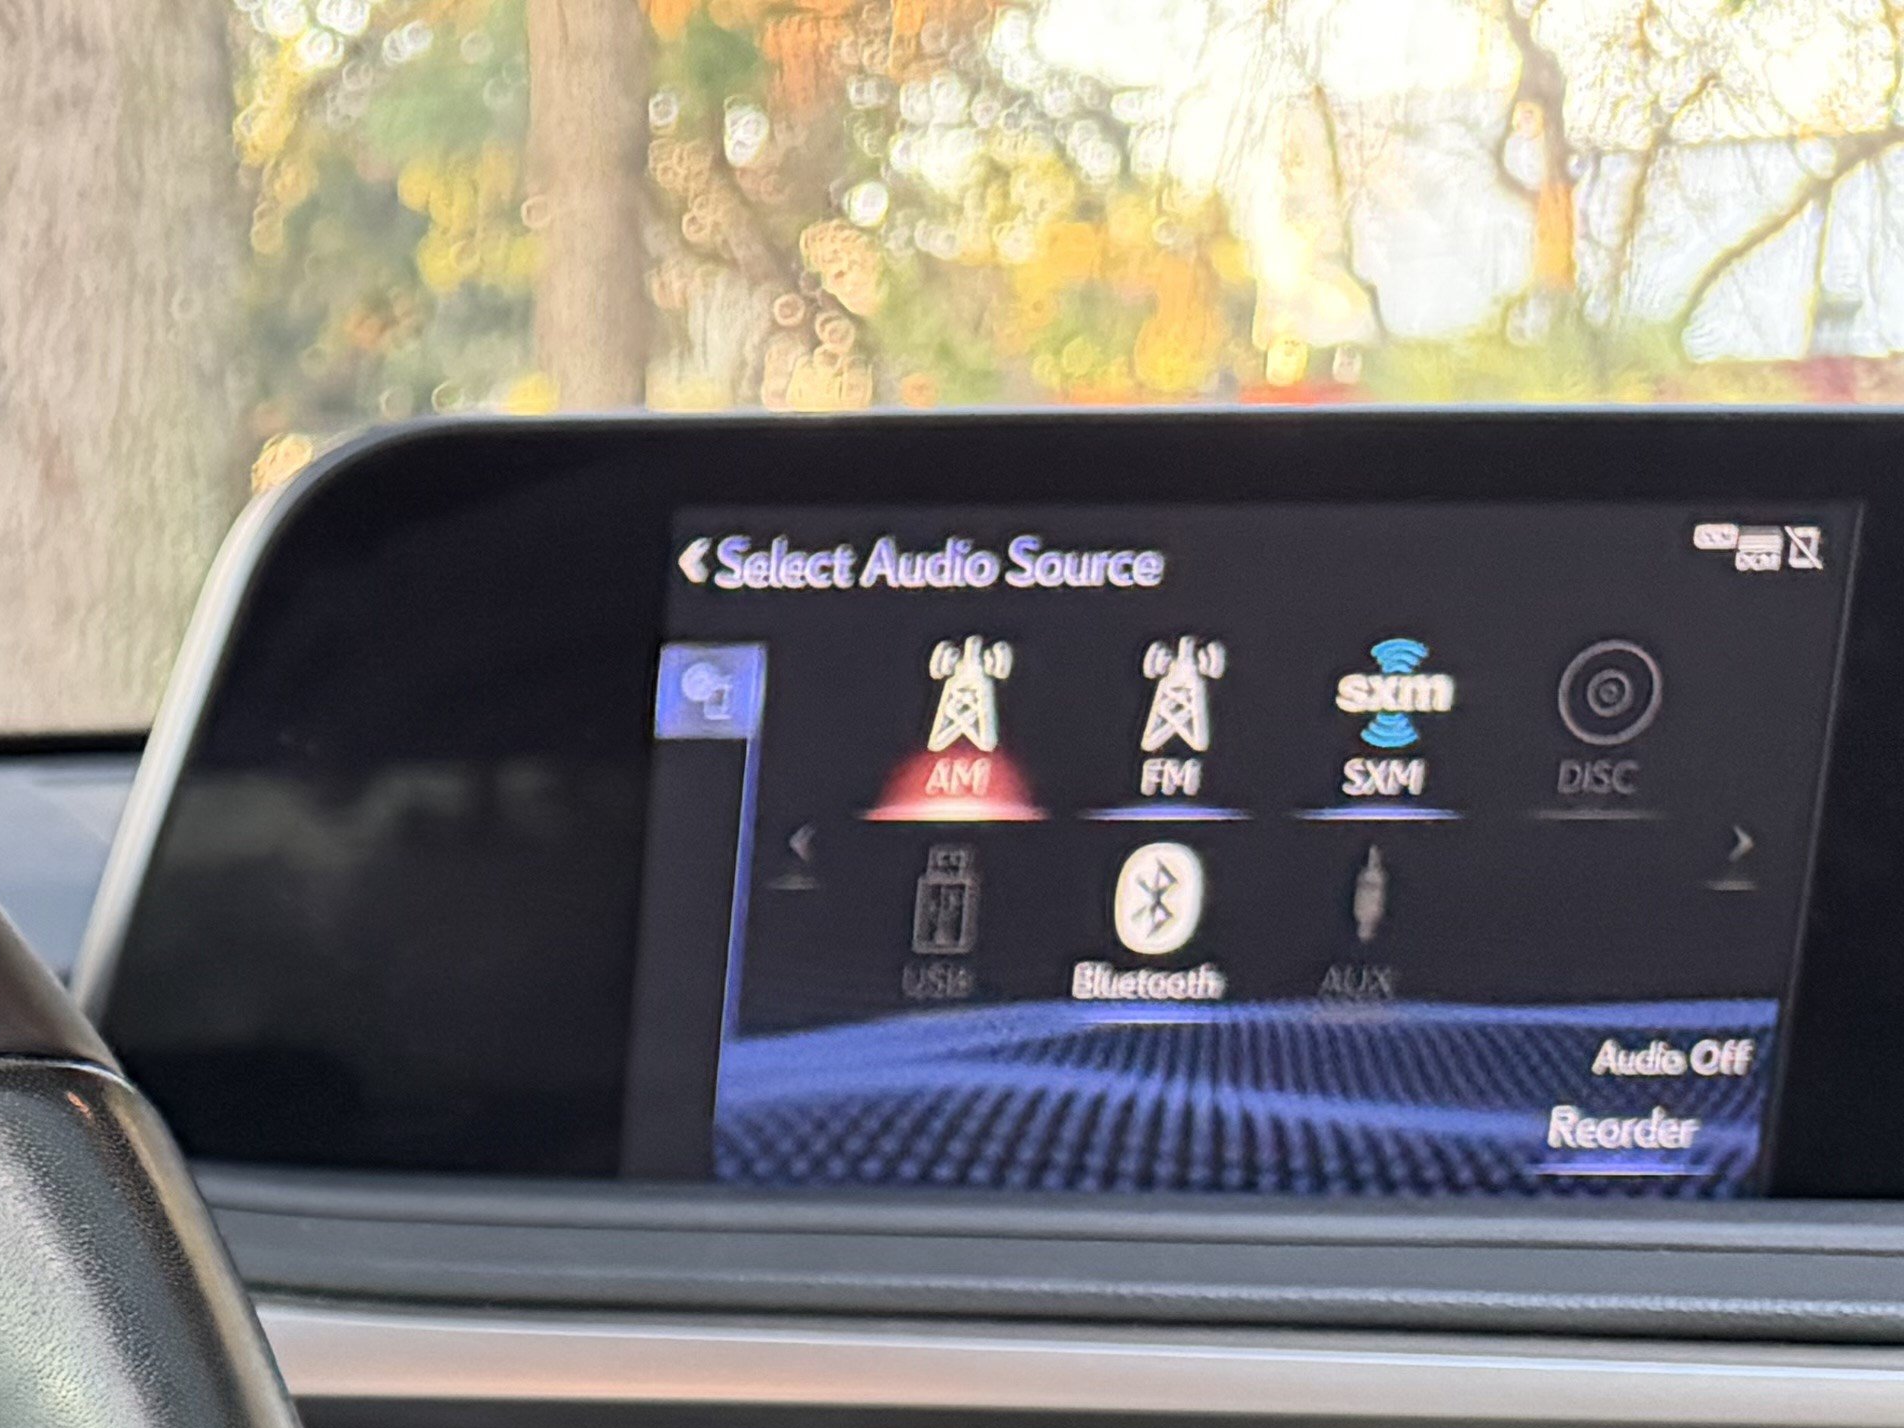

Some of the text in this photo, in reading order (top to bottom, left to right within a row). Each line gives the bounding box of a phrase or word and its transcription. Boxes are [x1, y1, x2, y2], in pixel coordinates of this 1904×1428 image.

[715, 536, 1164, 590] Select Audio Source
[926, 760, 988, 795] AM
[1139, 759, 1200, 796] FM
[1342, 760, 1425, 795] SXM
[1559, 760, 1639, 795] DISC
[902, 965, 974, 997] USB
[1072, 961, 1227, 999] Bluetooth
[1321, 965, 1395, 998] AUX
[1593, 1039, 1753, 1075] Audio Off
[1547, 1109, 1699, 1151] Reorder
